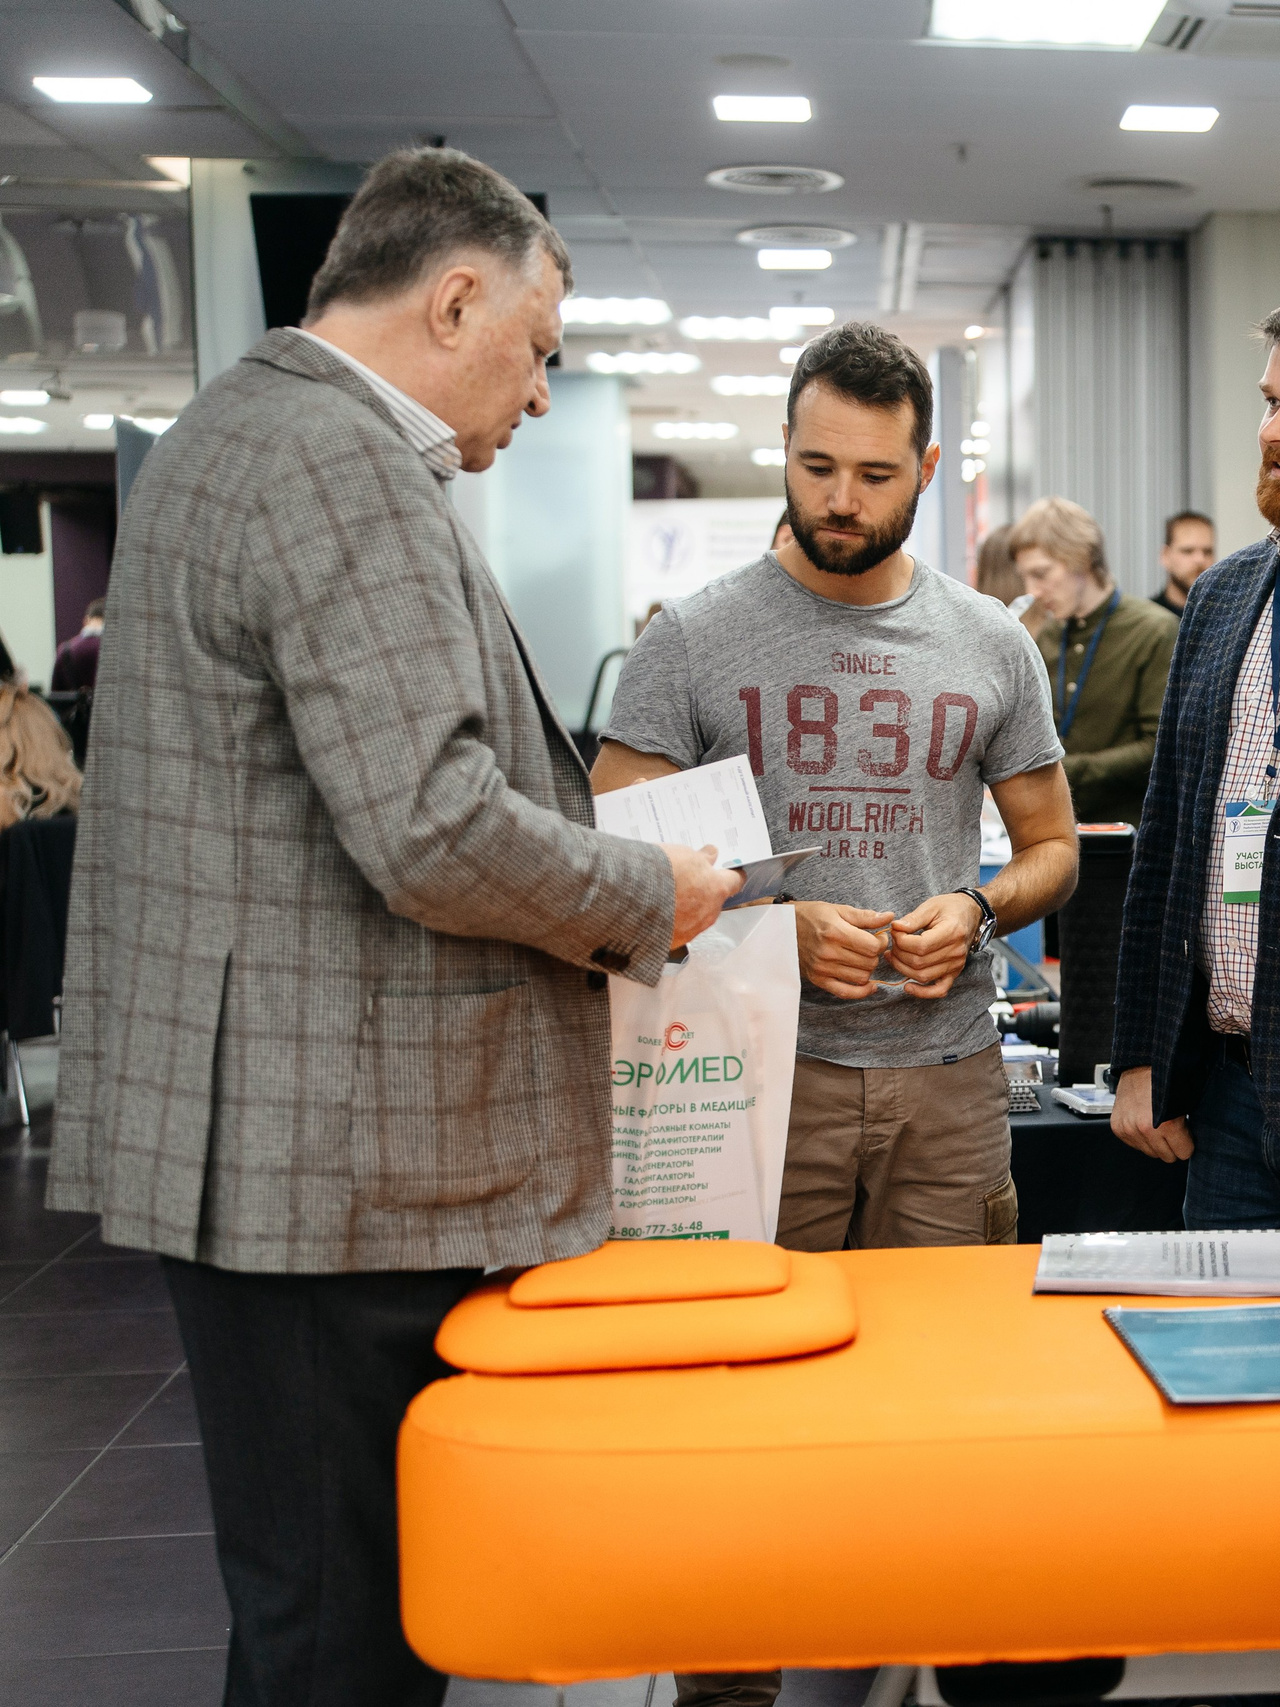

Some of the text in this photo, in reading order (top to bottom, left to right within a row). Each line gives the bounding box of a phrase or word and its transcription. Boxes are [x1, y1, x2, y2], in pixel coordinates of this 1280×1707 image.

[831, 651, 897, 676] SINCE
[739, 684, 979, 782] 1830
[789, 802, 924, 834] WOOLRICH
[637, 1031, 695, 1046] БОЛЕЕ ЛЕТ
[690, 1102, 697, 1112] В
[689, 1121, 731, 1131] КОМНАТЫ
